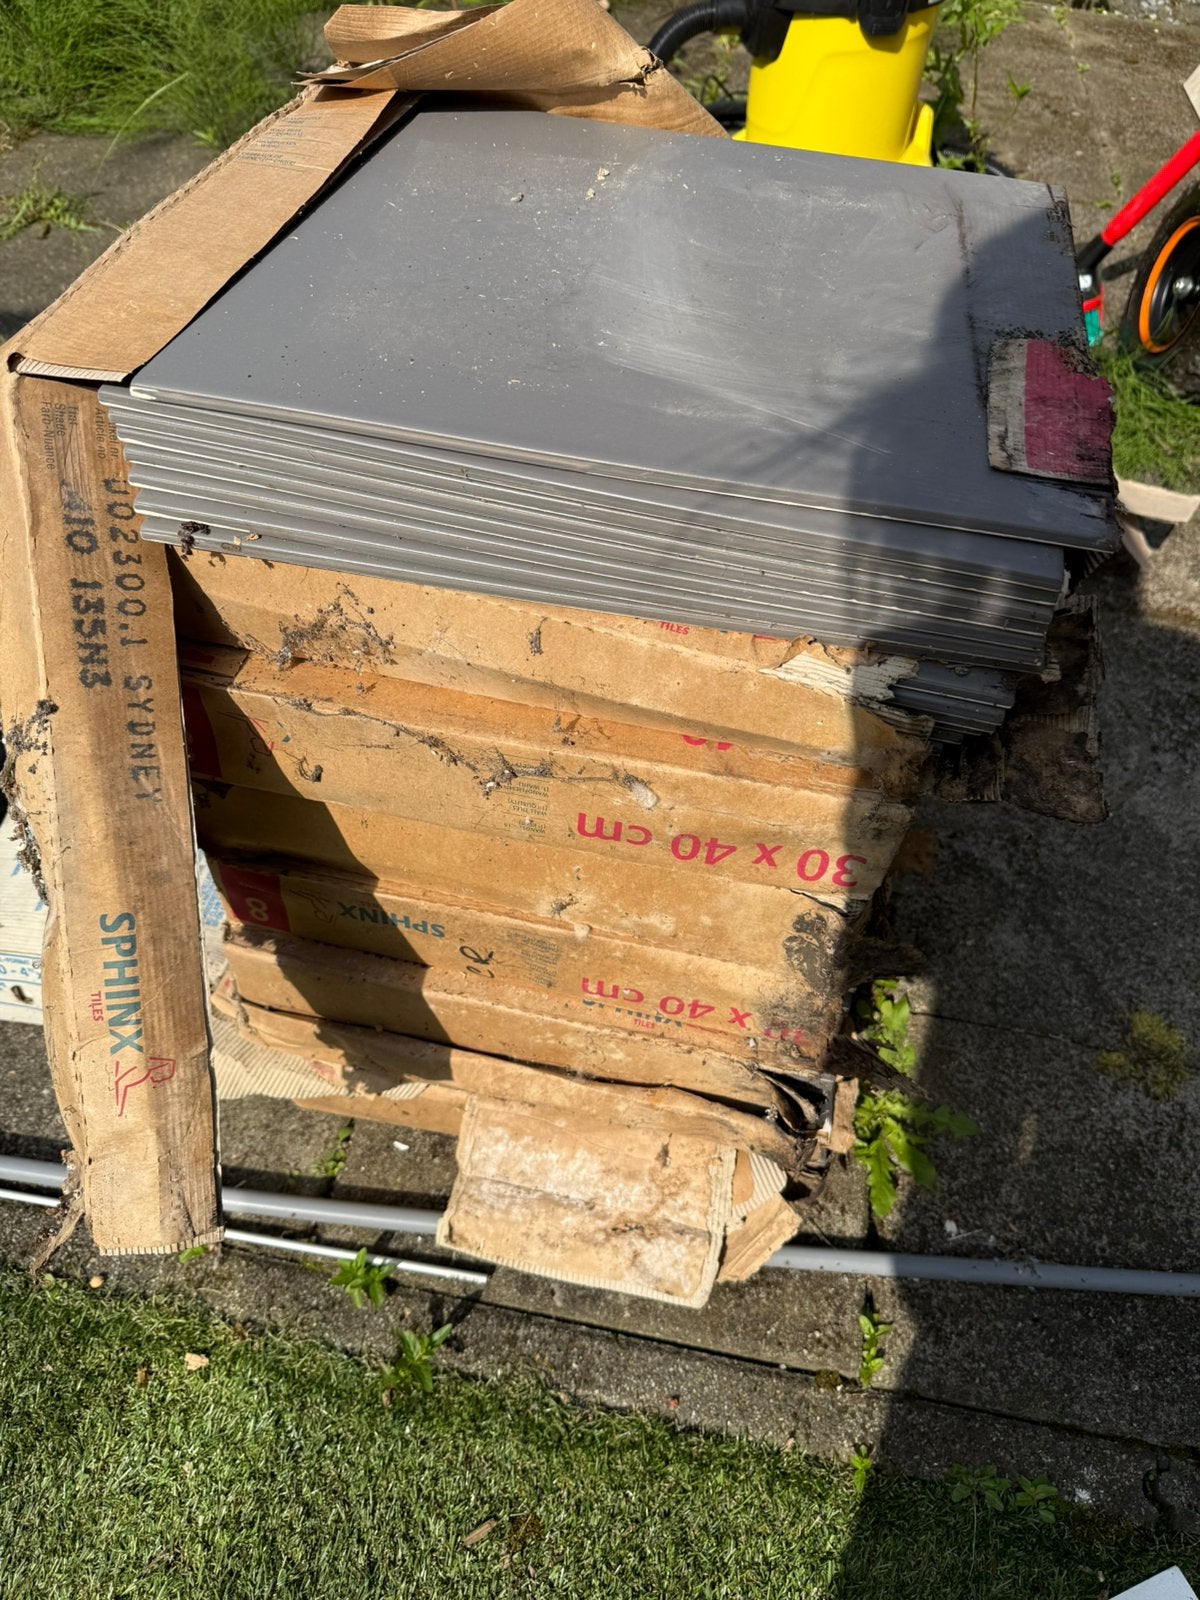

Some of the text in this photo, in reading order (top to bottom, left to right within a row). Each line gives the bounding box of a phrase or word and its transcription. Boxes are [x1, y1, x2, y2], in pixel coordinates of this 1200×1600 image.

[40, 400, 56, 470] Farb-Nuance
[54, 402, 66, 437] Shade
[95, 407, 106, 443] Article
[660, 620, 690, 636] TILES
[123, 674, 162, 803] SYDNEY
[576, 812, 867, 887] 30 x 40 cm
[245, 897, 269, 922] 8
[337, 901, 446, 938] SPHINX
[99, 911, 144, 1056] SPHINX
[581, 977, 645, 1003] cm
[91, 990, 104, 1022] TILES
[658, 996, 716, 1019] 40
[727, 1007, 753, 1028] x
